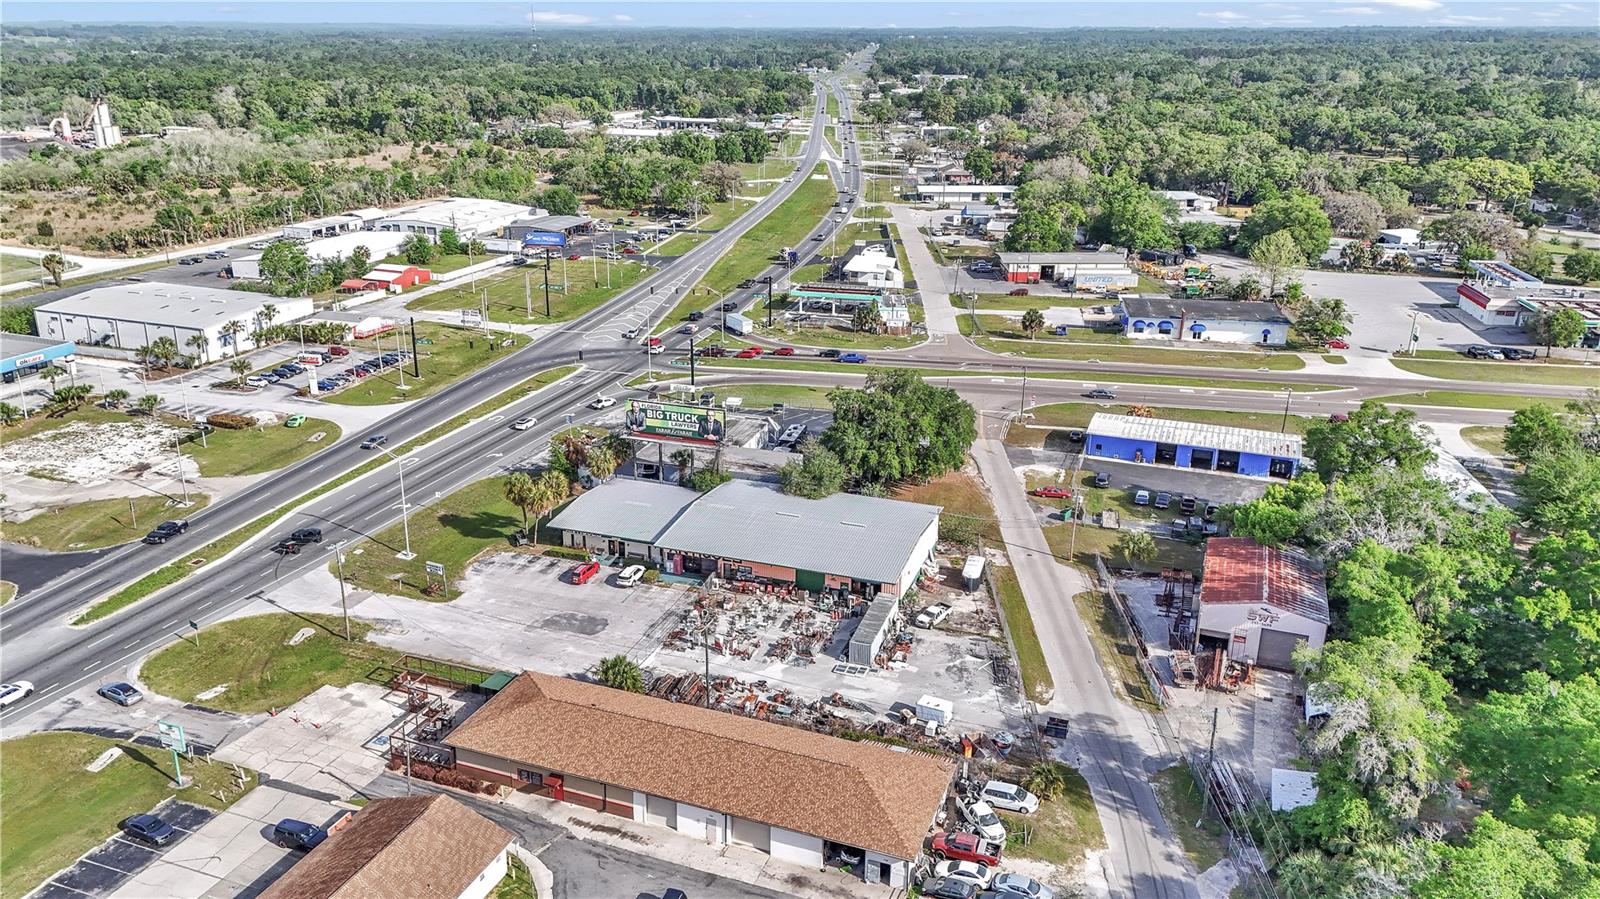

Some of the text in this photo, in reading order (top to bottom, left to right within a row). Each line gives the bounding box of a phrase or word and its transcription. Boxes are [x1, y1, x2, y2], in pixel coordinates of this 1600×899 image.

[1085, 275, 1113, 283] UNITED
[646, 410, 699, 423] BIG TRUCK
[1246, 612, 1280, 624] SWF
